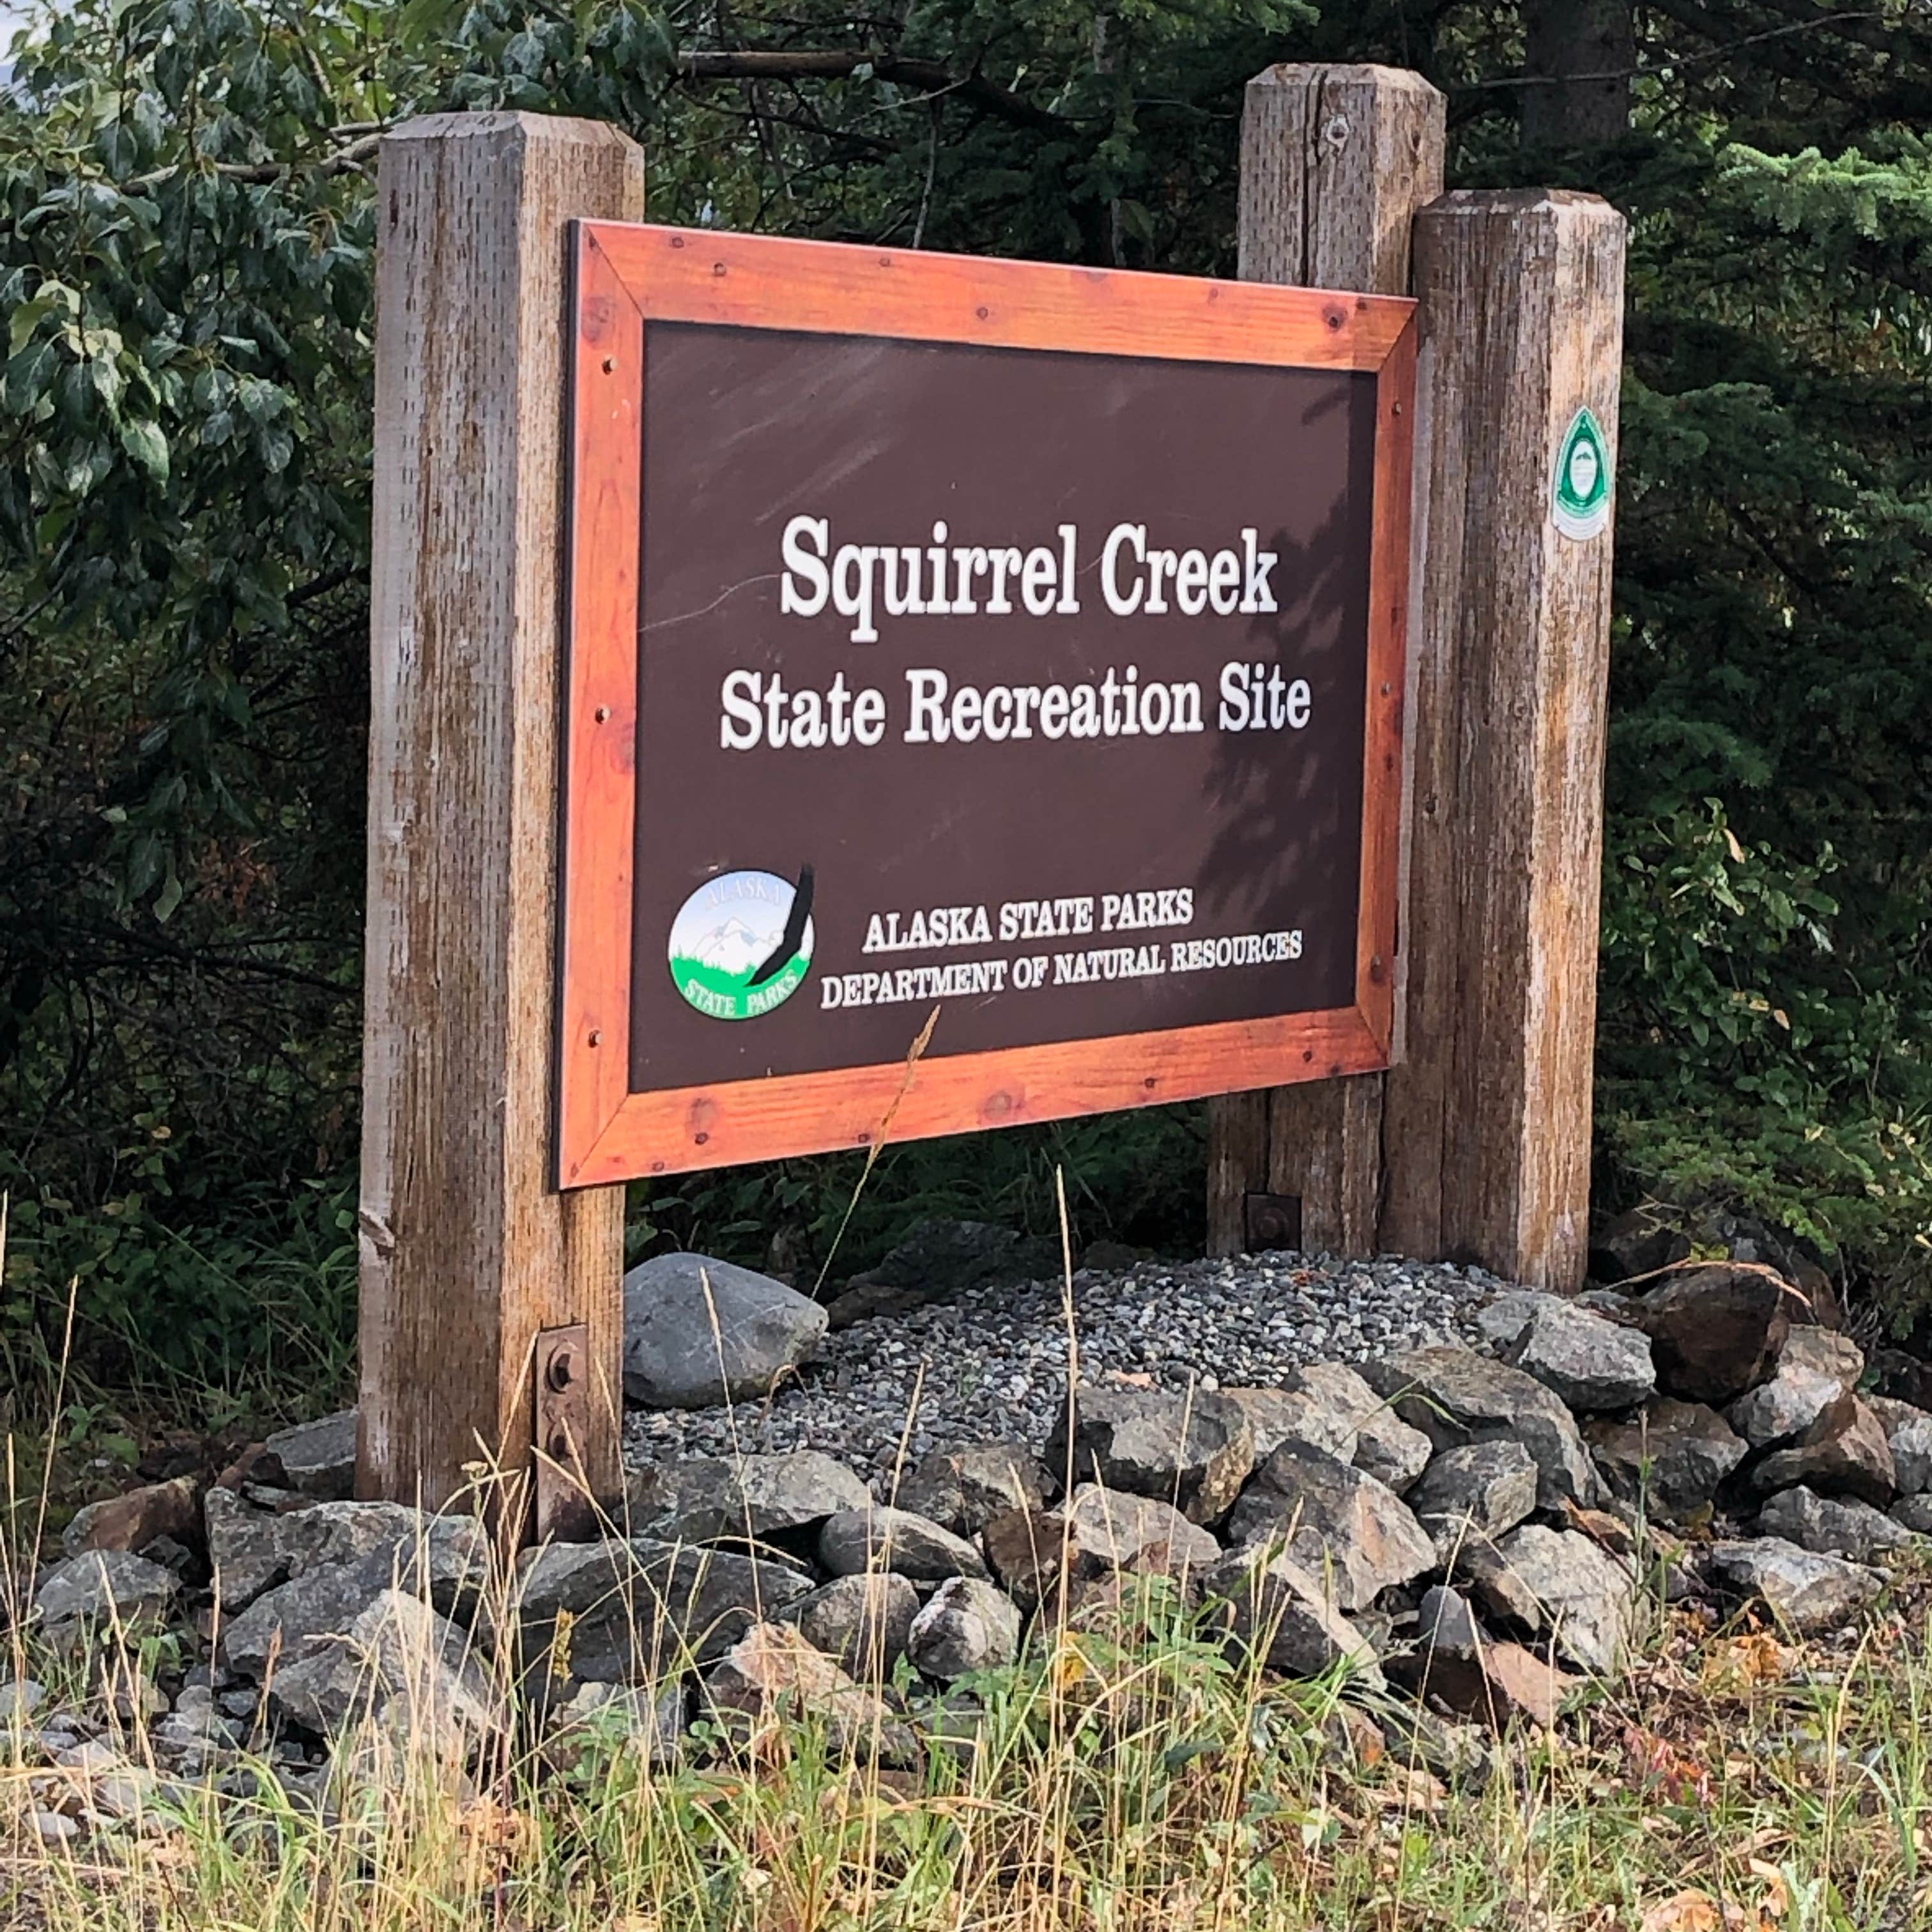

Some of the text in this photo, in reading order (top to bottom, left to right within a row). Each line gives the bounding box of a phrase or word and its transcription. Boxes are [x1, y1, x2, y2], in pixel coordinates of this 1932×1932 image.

[781, 515, 1278, 643] Squirrel Creek
[721, 661, 1311, 750] State Recreation Site
[707, 876, 781, 909] ALASKA
[861, 887, 1194, 954] ALASKA STATE PARKS
[684, 969, 799, 1016] STATE PARKS
[820, 930, 1303, 1010] DEPARTMENT OF NATURAL RESOURCES
